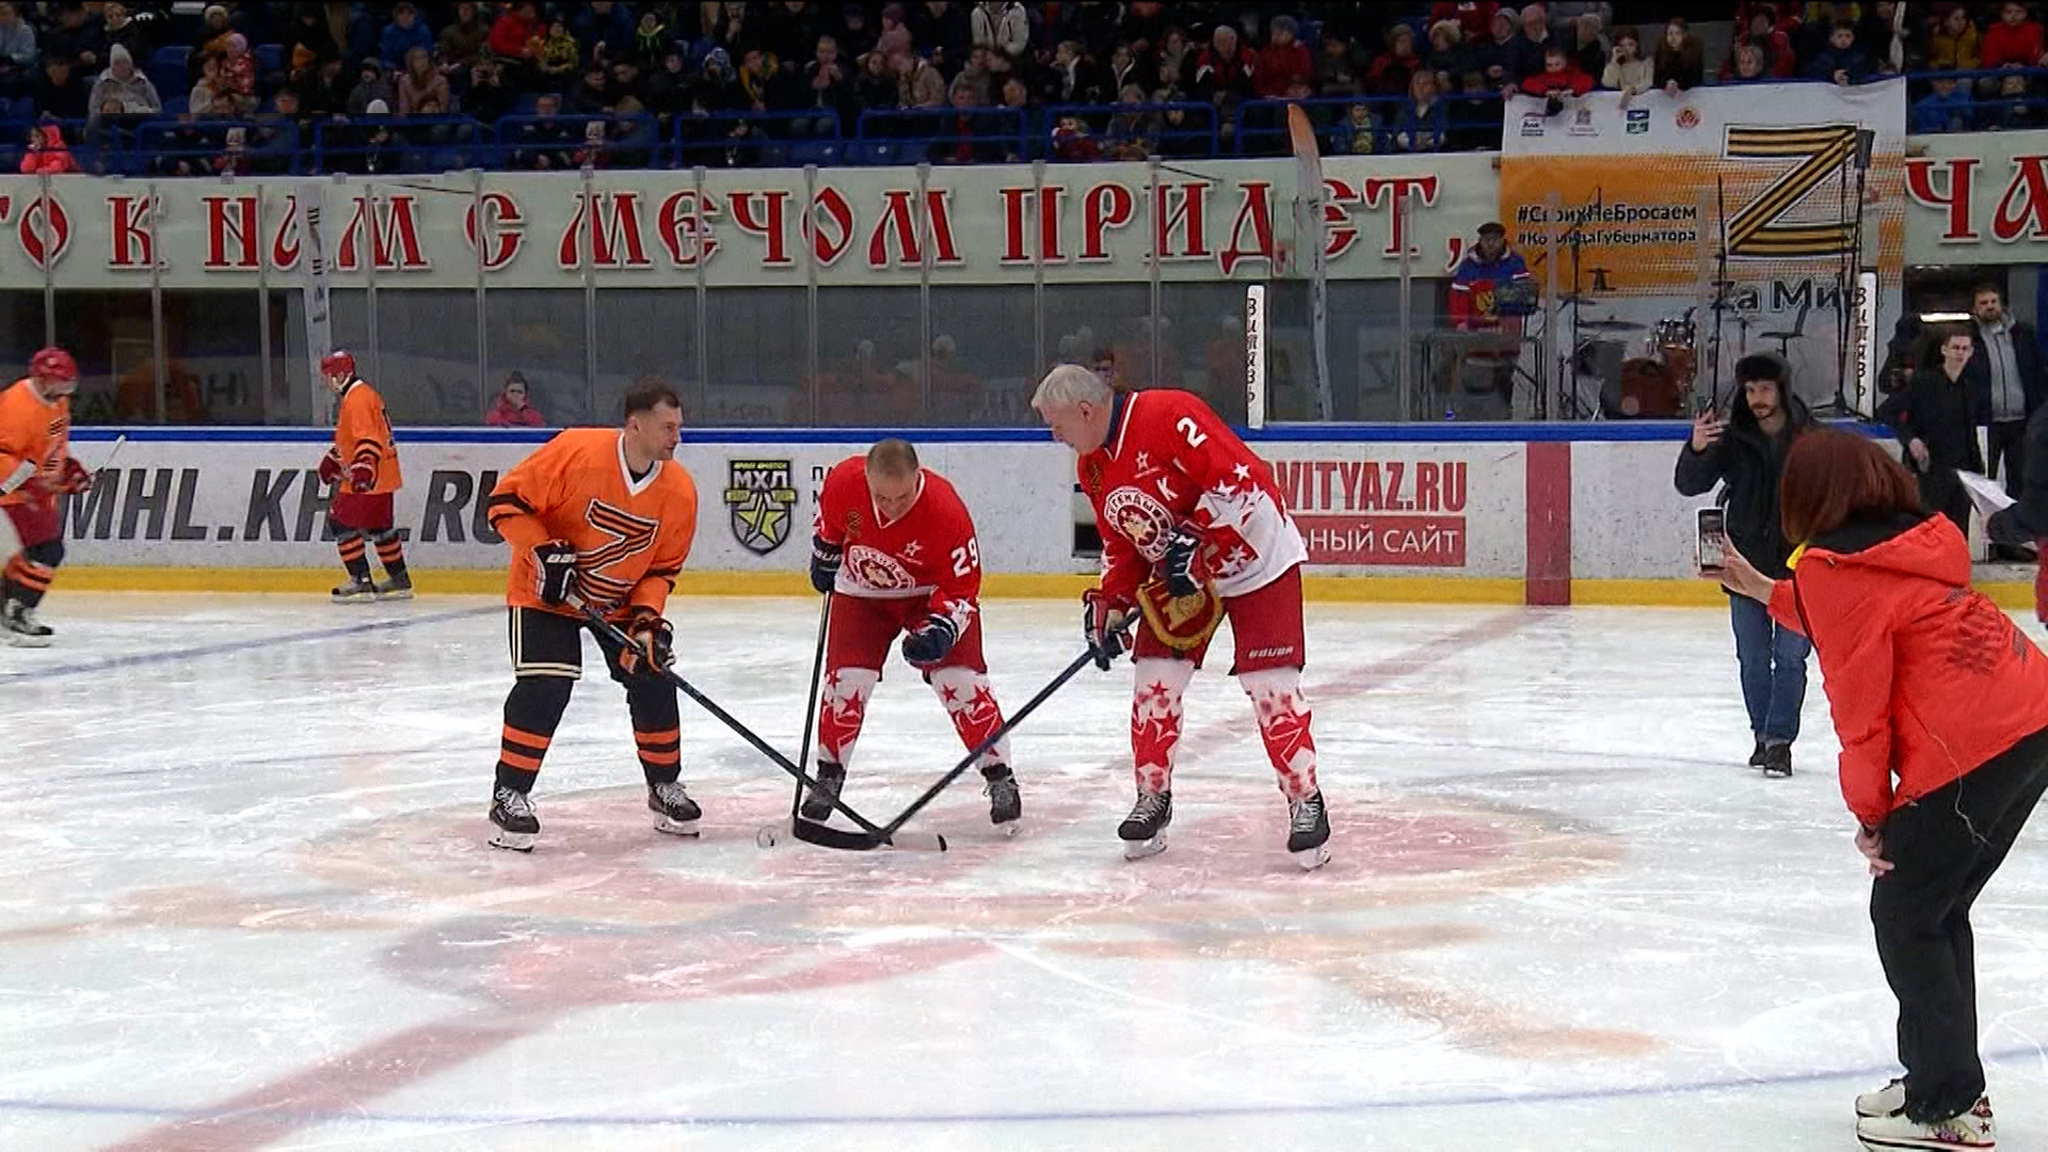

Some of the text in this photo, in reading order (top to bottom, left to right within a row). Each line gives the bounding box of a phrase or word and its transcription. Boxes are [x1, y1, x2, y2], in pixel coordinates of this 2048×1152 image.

[466, 193, 522, 268] С
[560, 186, 958, 268] МЕЧОМ
[1177, 417, 1208, 448] 2
[733, 470, 788, 488] МХЛ
[60, 468, 505, 543] MHL.KH.RU
[1383, 524, 1460, 553] САЙТ
[951, 537, 980, 578] 29
